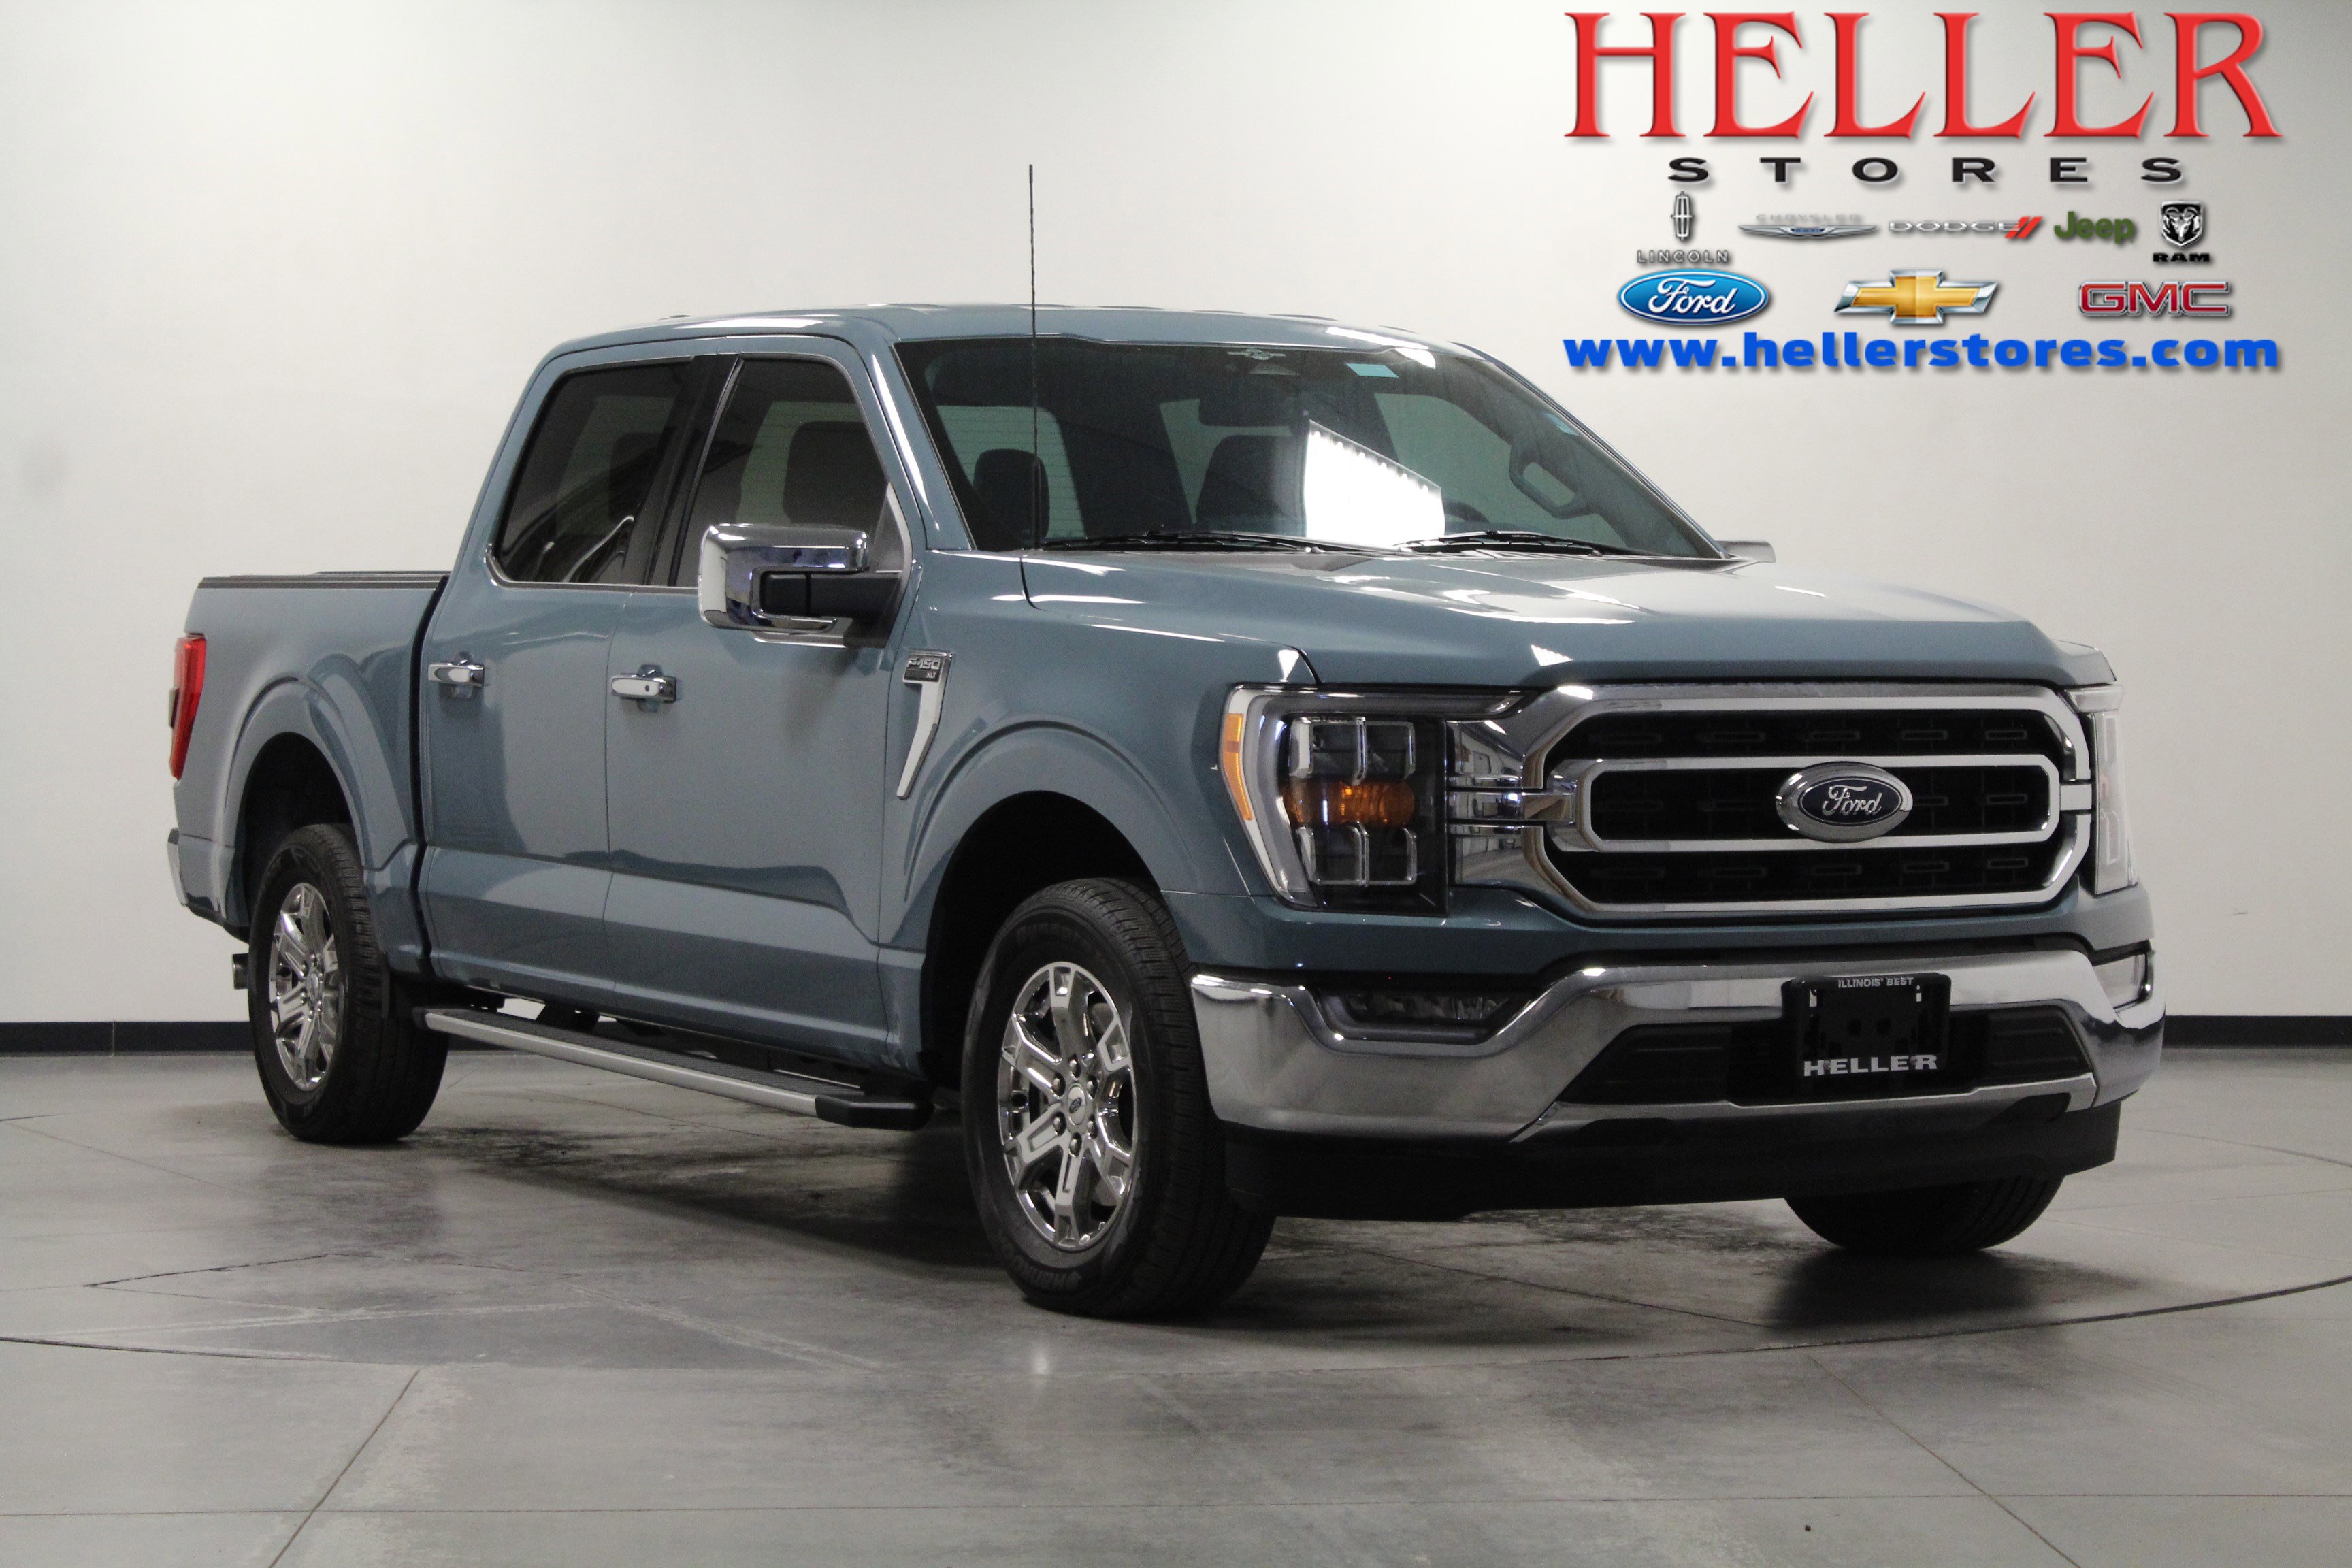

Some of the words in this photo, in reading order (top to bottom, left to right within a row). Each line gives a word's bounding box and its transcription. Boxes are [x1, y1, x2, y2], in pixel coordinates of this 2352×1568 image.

[1821, 784, 1883, 817] Ford
[1886, 976, 1914, 987] BEST
[1803, 1054, 1938, 1077] HELLER
